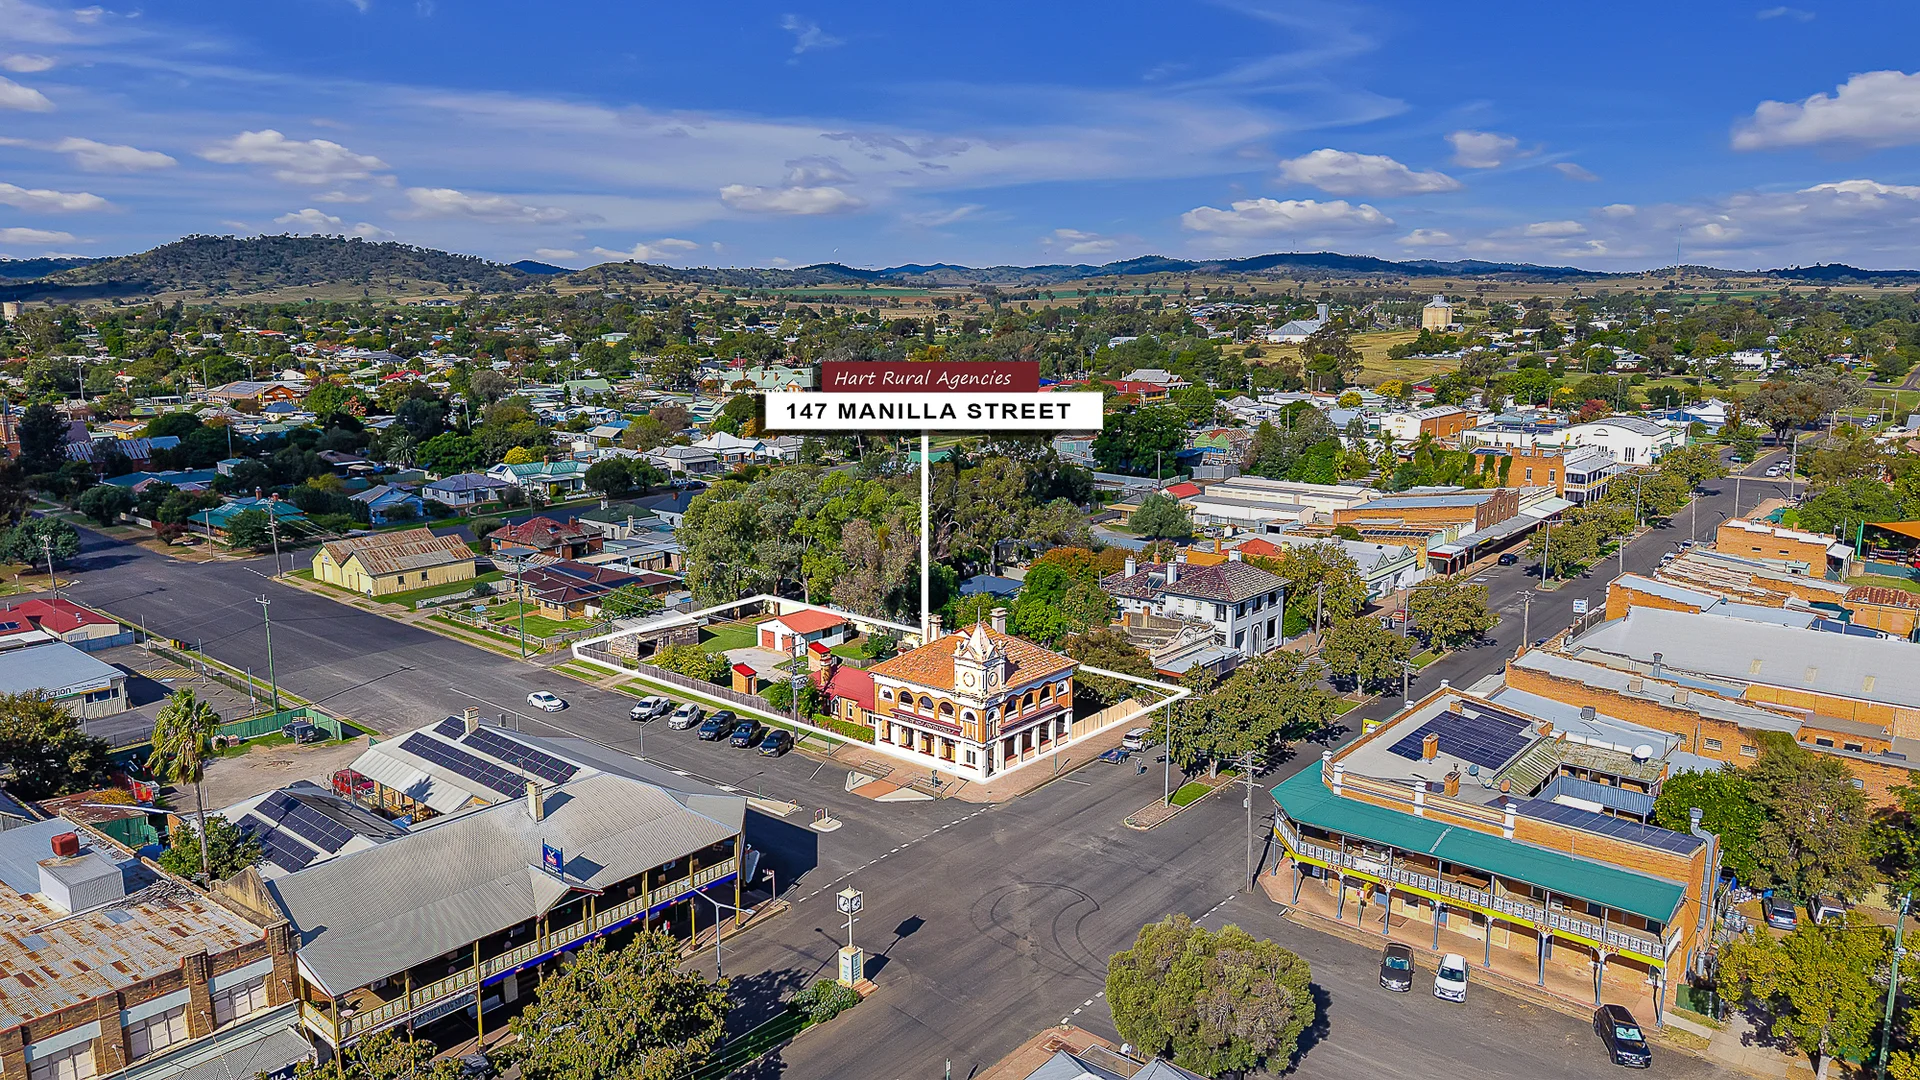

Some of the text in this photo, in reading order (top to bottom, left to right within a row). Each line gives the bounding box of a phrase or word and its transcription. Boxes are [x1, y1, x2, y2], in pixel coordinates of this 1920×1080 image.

[1326, 864, 1344, 873] XXXX
[1379, 879, 1397, 888] XXXX
[1533, 923, 1554, 934] XXXX
[1598, 942, 1620, 954] XXXX
